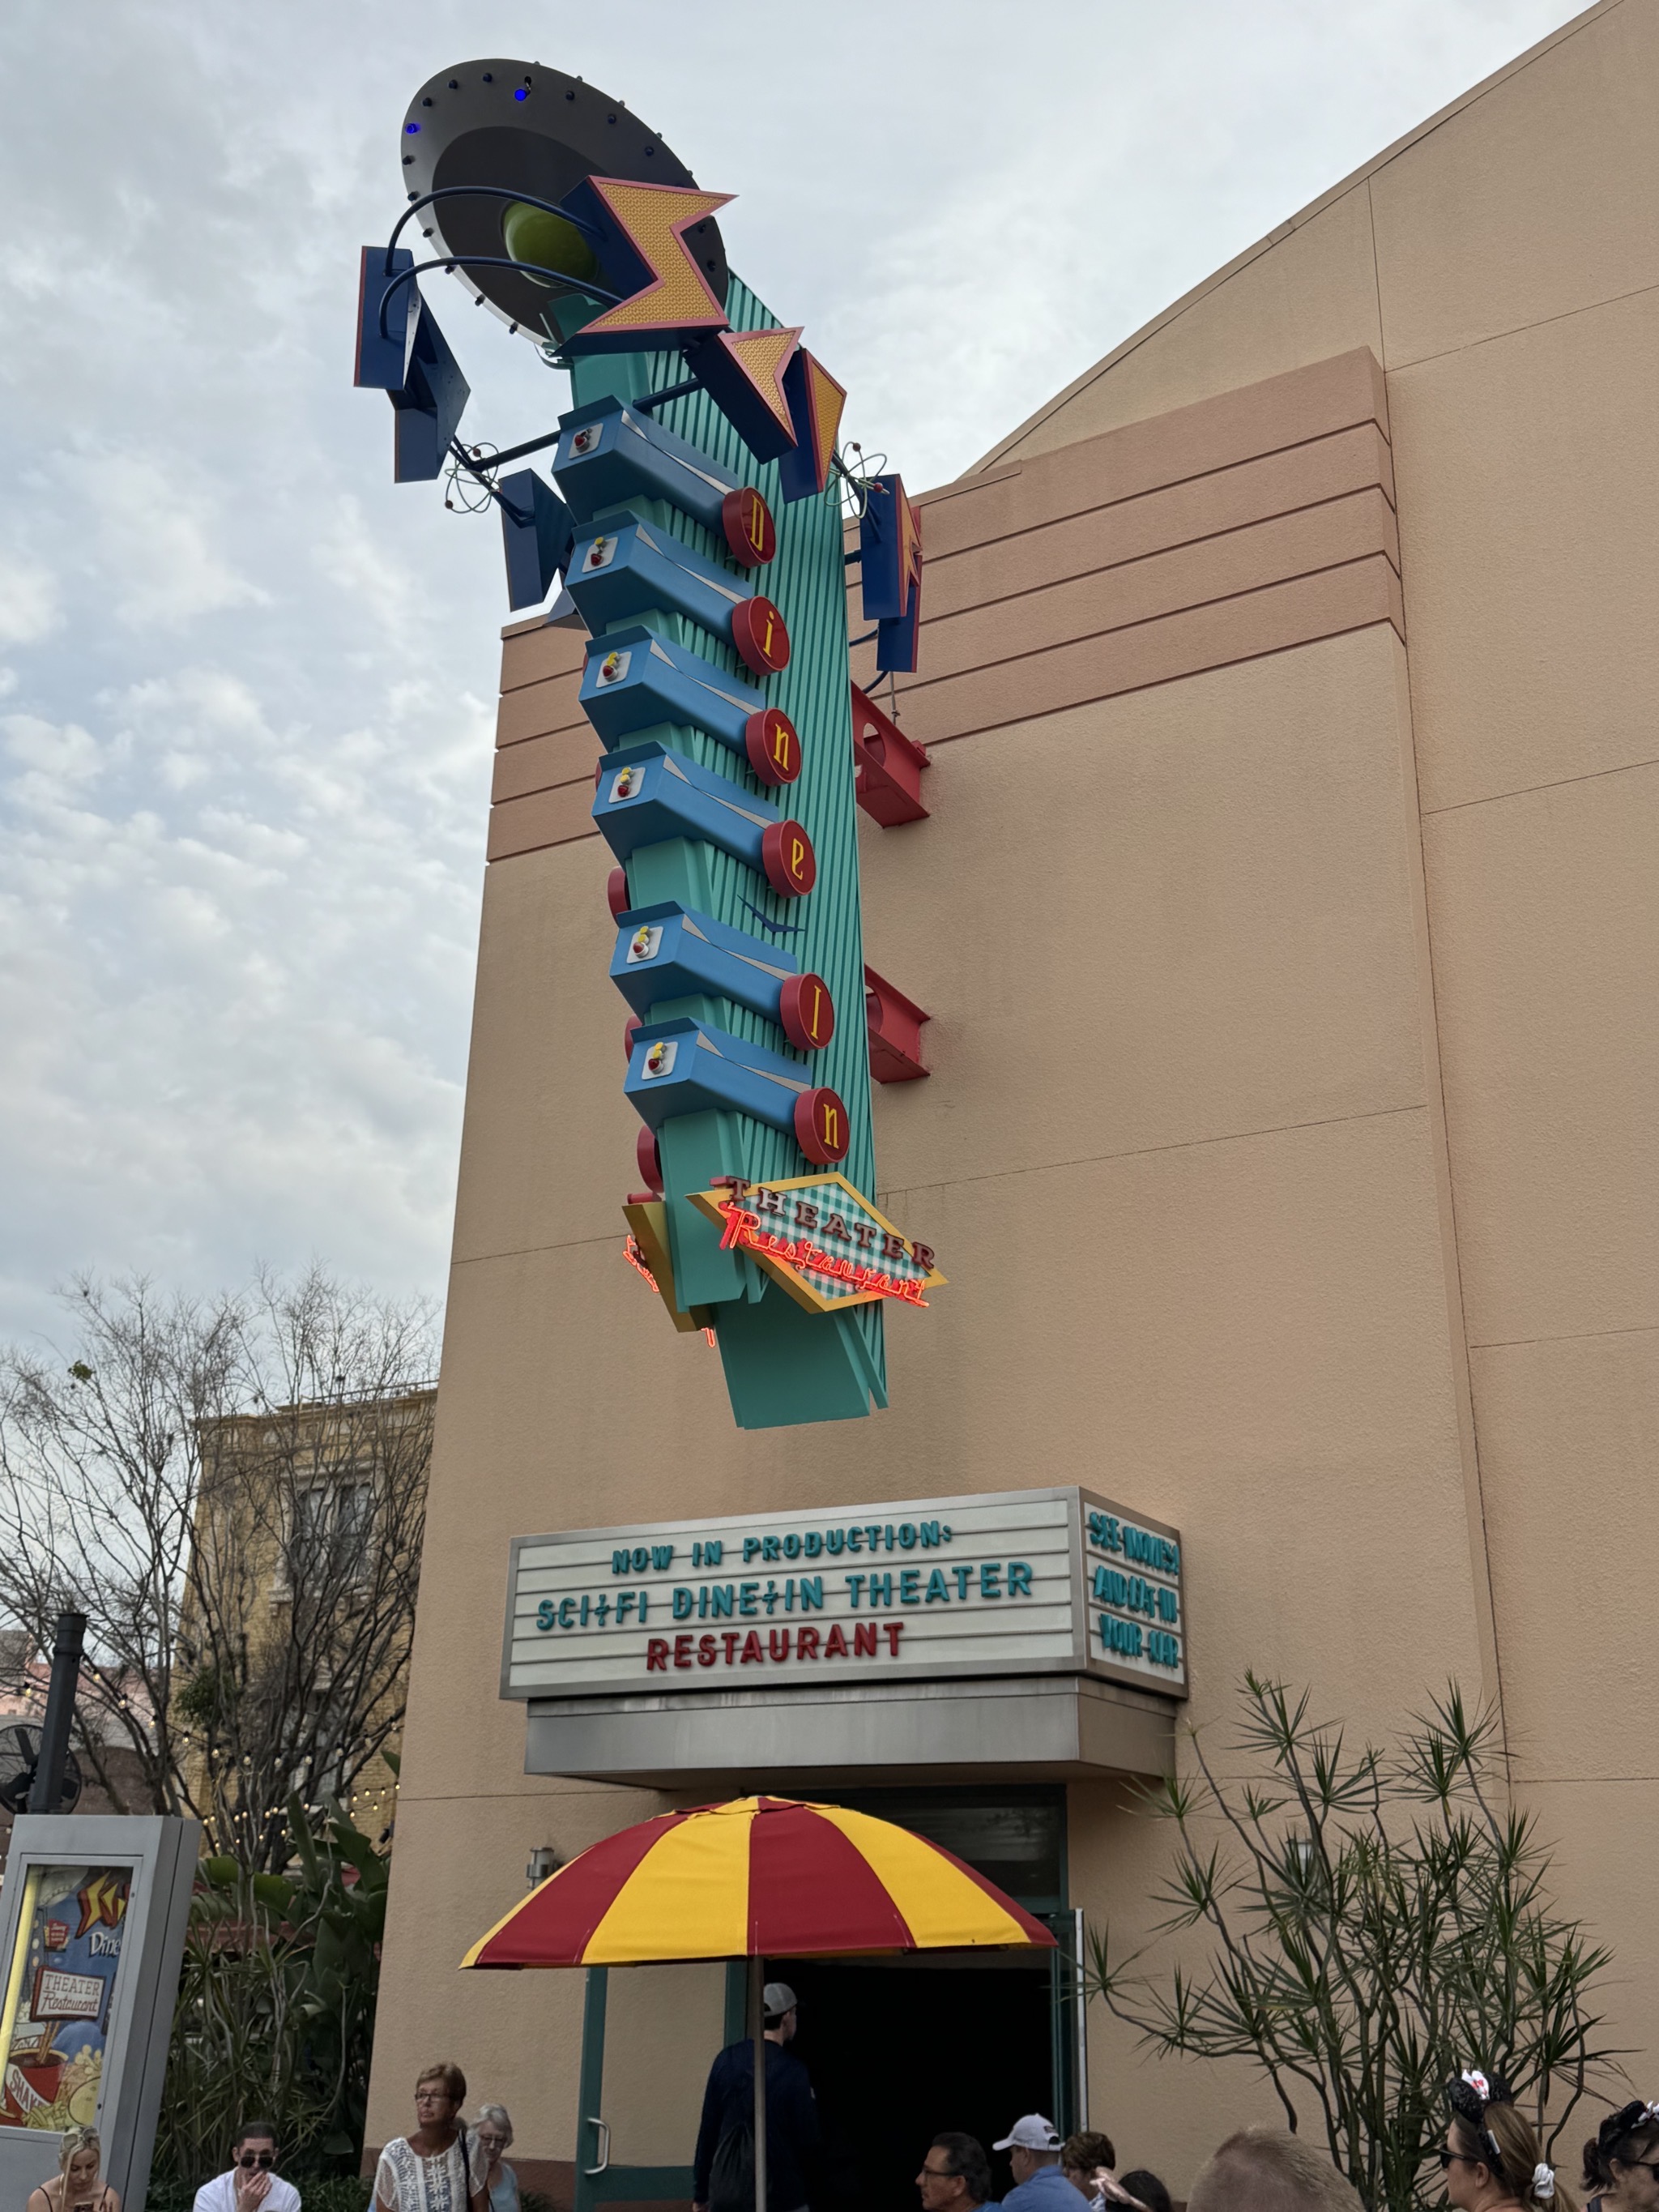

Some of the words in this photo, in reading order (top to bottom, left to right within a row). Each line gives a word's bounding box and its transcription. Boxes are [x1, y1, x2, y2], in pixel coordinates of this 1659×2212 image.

[727, 1176, 935, 1269] THEATER
[719, 1201, 929, 1308] Restaurant
[612, 1544, 673, 1574] NOW
[692, 1540, 722, 1567] IN
[743, 1520, 952, 1563] PRODUCTION:
[1090, 1512, 1122, 1552] SEE
[845, 1561, 1033, 1608] THEATER
[646, 1621, 904, 1671] RESTAURANT
[41, 1990, 98, 2012] Restaurant
[45, 1974, 100, 1996] THEATER
